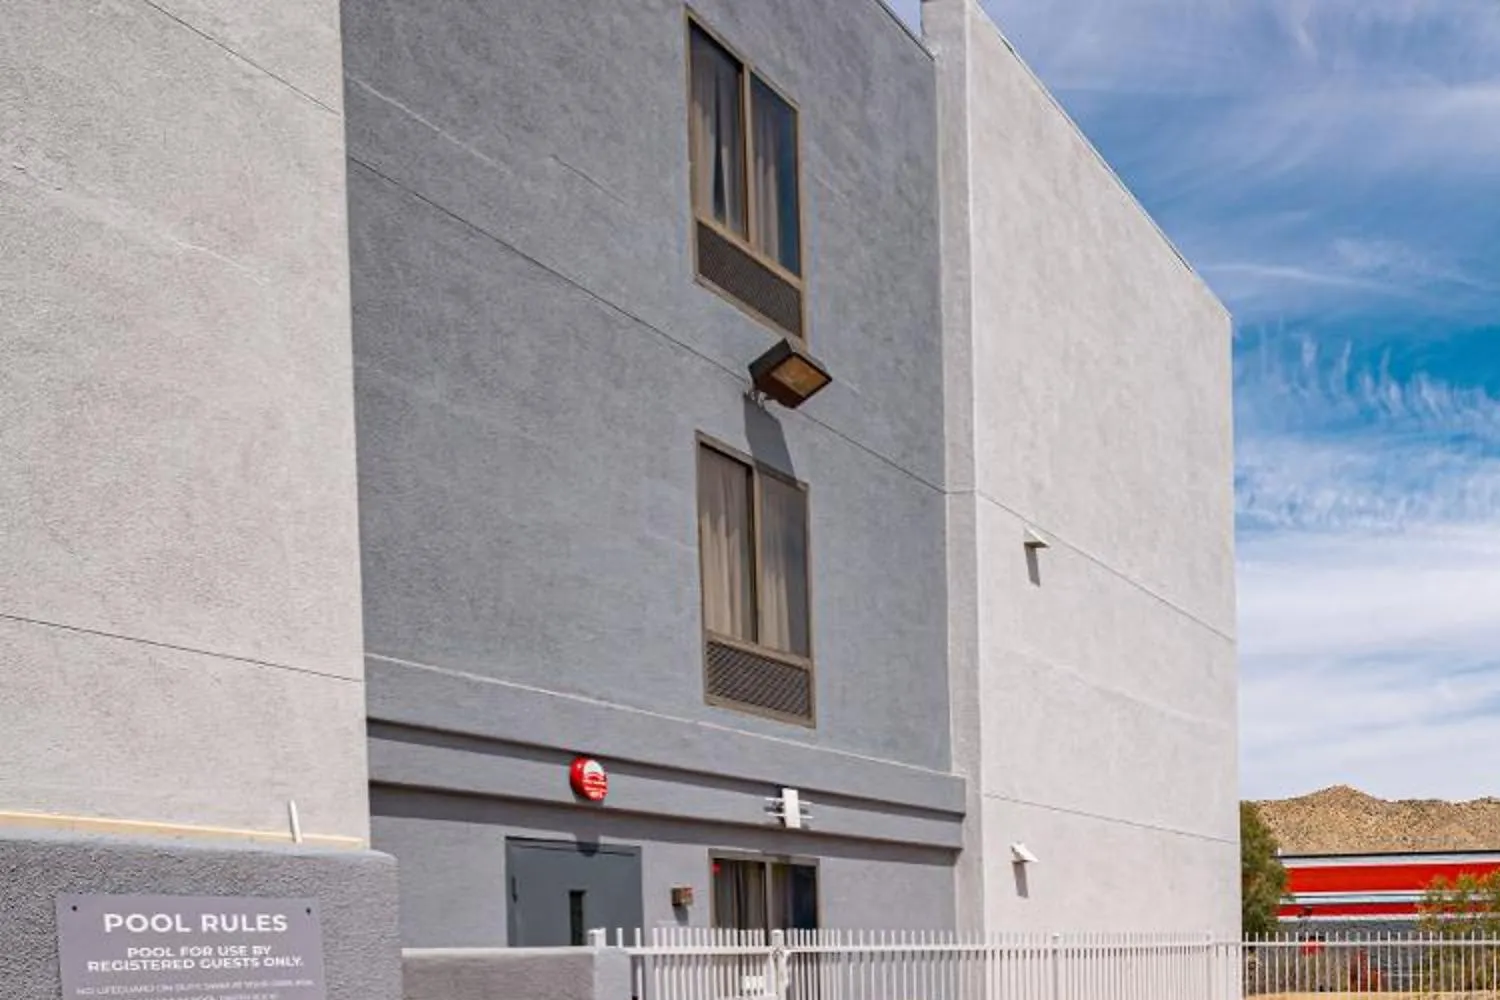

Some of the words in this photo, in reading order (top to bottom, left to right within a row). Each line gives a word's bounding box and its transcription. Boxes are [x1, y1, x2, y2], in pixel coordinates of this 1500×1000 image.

[103, 913, 192, 933] POOL
[201, 914, 288, 933] RULES
[127, 947, 176, 959] POOL
[180, 946, 213, 958] FOR
[217, 945, 248, 957] USE
[253, 945, 272, 957] BY
[87, 959, 196, 973] REGISTERED
[200, 958, 259, 970] GUESTS
